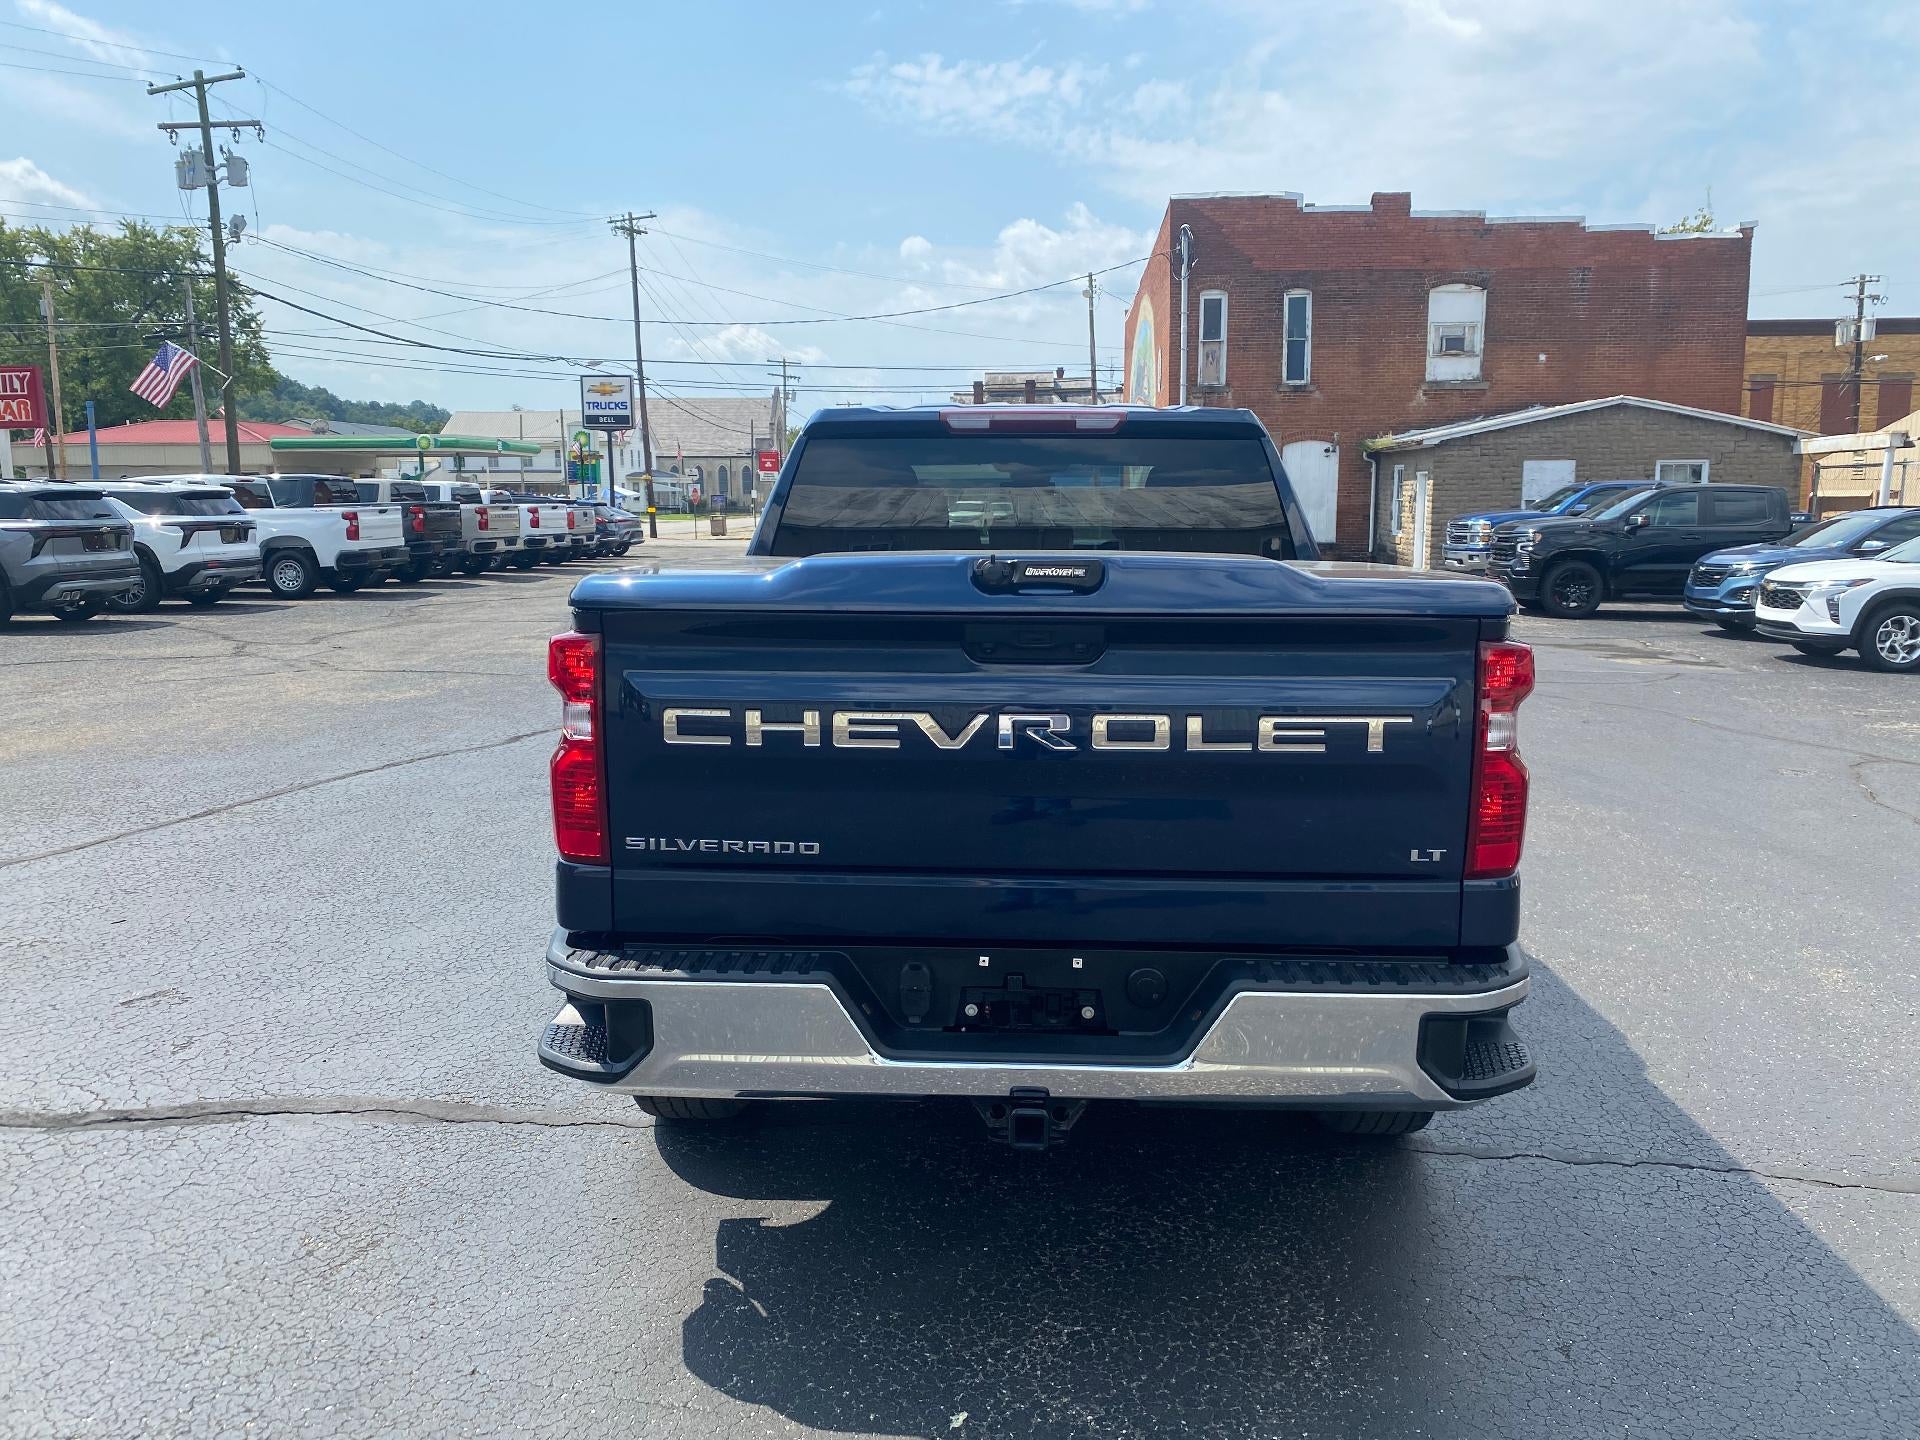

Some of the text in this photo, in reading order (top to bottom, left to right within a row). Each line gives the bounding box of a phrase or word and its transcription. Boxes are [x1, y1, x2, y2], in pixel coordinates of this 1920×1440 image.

[585, 401, 628, 410] TRUCKS
[663, 708, 1413, 752] CHEVROLET
[625, 836, 820, 855] SILVERADO
[1410, 849, 1447, 861] LT
